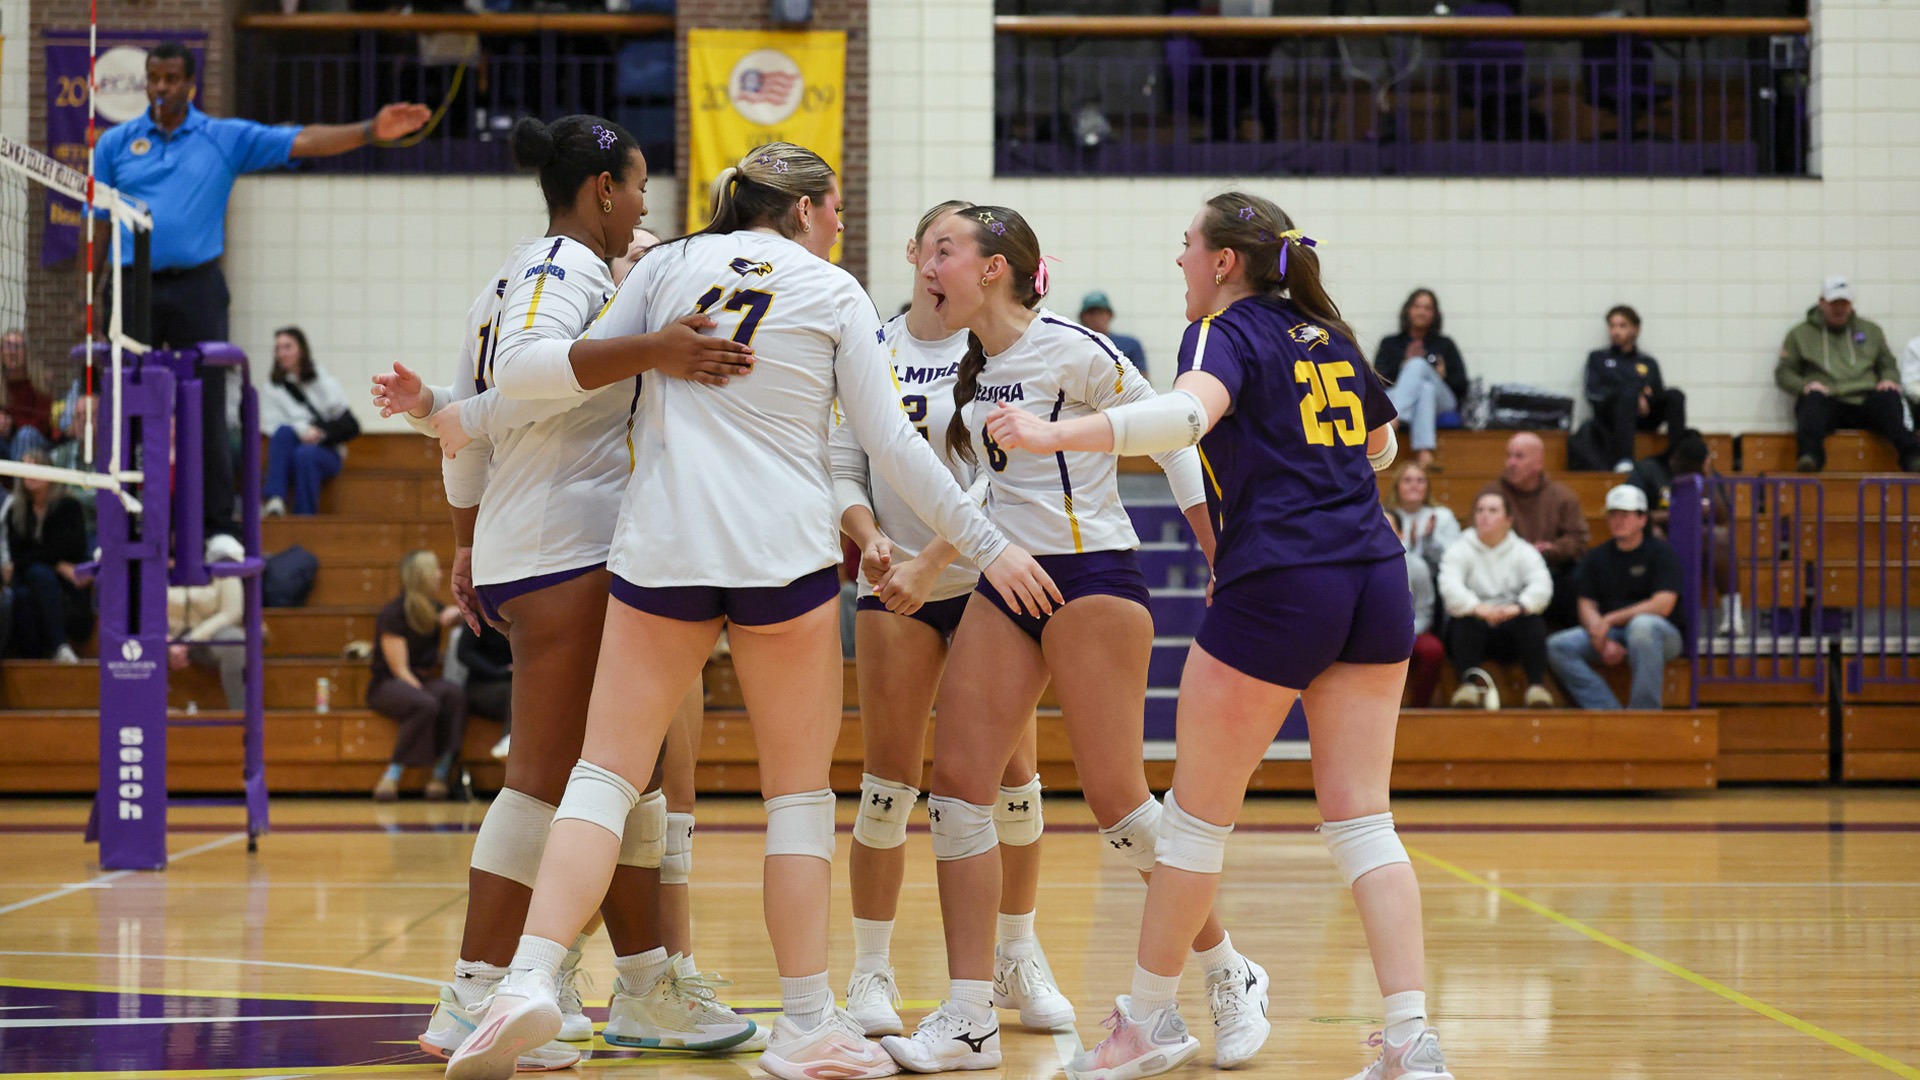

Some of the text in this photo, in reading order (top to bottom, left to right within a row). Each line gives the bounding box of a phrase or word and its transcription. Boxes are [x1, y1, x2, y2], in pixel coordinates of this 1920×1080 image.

[55, 76, 88, 107] 20
[894, 362, 960, 384] LMIRA
[1294, 360, 1367, 447] 25
